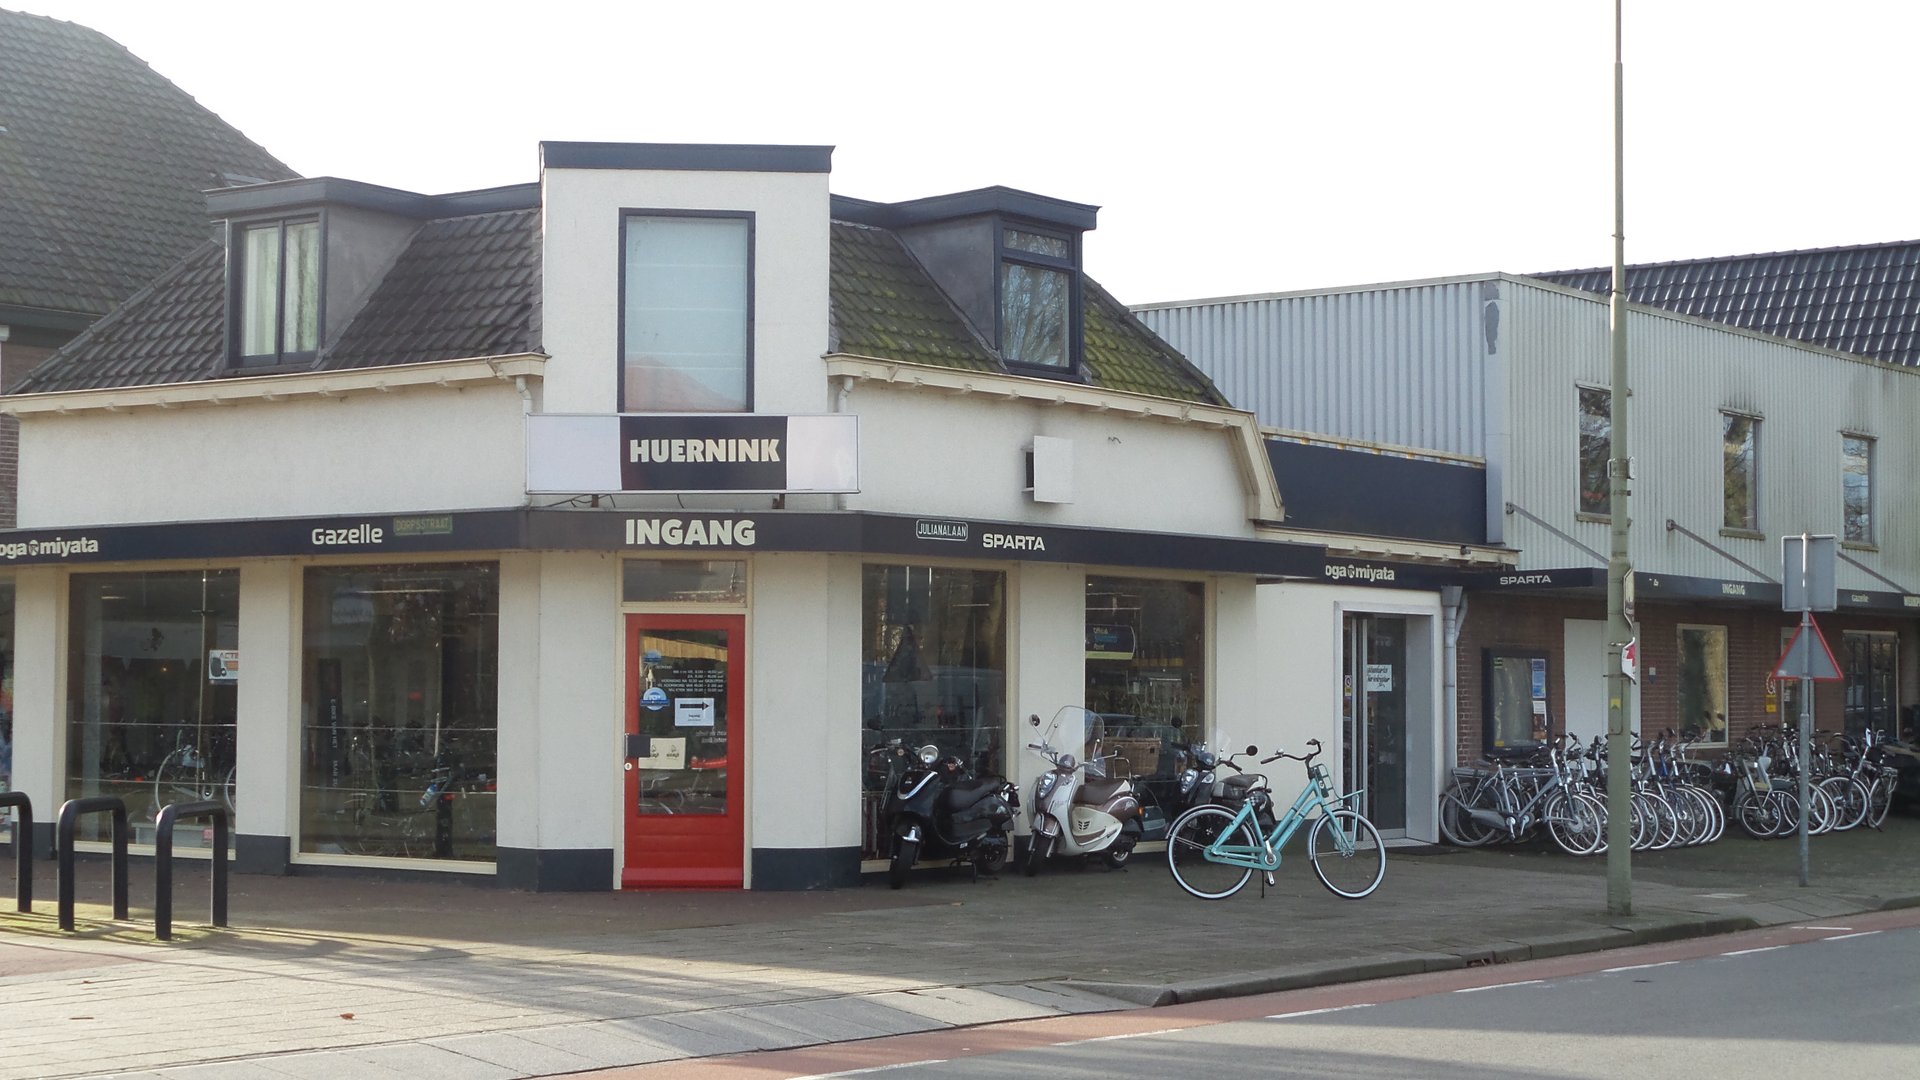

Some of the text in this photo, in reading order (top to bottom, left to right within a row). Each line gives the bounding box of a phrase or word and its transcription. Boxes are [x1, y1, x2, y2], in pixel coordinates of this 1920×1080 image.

[629, 439, 781, 463] HUERNINK
[311, 524, 384, 545] Gazelle
[625, 519, 756, 546] INGANG
[918, 523, 966, 537] JULIANALAAN
[0, 537, 99, 559] oga miyata
[982, 533, 1046, 551] SPARTA
[1325, 564, 1395, 582] oga miyata
[1500, 575, 1552, 585] SPARTA
